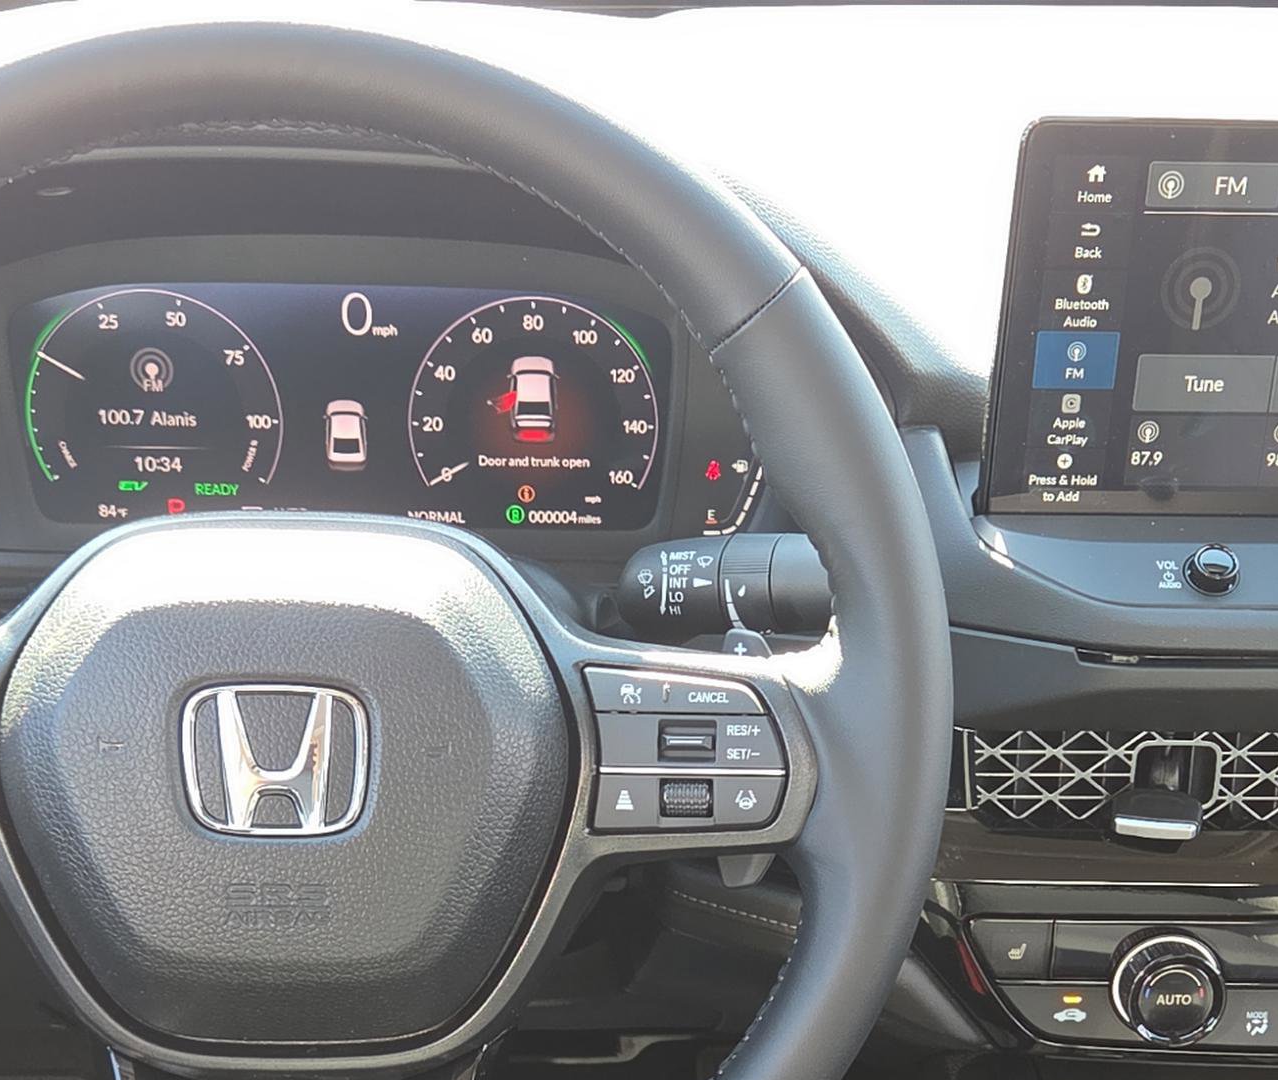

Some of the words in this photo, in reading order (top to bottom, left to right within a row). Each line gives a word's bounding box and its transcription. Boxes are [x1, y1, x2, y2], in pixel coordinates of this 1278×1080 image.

[1215, 177, 1248, 196] FM
[1077, 190, 1112, 203] Home
[1074, 246, 1102, 260] Back
[1054, 298, 1109, 311] Bluetooth
[99, 313, 119, 330] 25
[166, 311, 187, 328] 50
[341, 292, 373, 336] 0
[372, 324, 398, 339] mph
[1063, 315, 1097, 328] Audio
[523, 315, 544, 331] 80
[472, 329, 493, 344] 60
[572, 330, 598, 345] 100
[223, 350, 245, 366] 75
[434, 366, 456, 382] 40
[610, 368, 635, 384] 120
[1065, 368, 1084, 380] FM
[143, 379, 163, 393] FM
[1184, 375, 1224, 393] Tune
[98, 410, 144, 426] 100.7
[150, 411, 197, 427] Alanis
[246, 414, 271, 429] 100
[423, 417, 444, 432] 20
[1053, 417, 1086, 431] Apple
[623, 420, 648, 434] 140
[1047, 433, 1089, 447] CarPlay
[134, 456, 182, 472] 10:34
[478, 455, 506, 468] Door
[508, 455, 528, 468] and
[531, 455, 560, 468] trunk
[562, 458, 590, 470] open
[1130, 451, 1163, 467] 87.9
[608, 470, 633, 485] 160
[1028, 474, 1056, 487] Press
[1059, 474, 1068, 486] &
[1070, 474, 1097, 487] Hold
[194, 482, 239, 495] READY
[1042, 491, 1054, 503] to
[1057, 490, 1080, 503] Add
[528, 510, 577, 525] 000004
[707, 509, 715, 520] E
[669, 550, 697, 561] MIST
[669, 564, 692, 576] OFF
[1156, 560, 1179, 570] VOL
[669, 577, 689, 589] INT
[669, 592, 684, 603] LO
[669, 605, 682, 615] HI
[688, 692, 729, 704] CANCEL
[726, 724, 761, 737] RES/+
[1156, 992, 1192, 1006] AUTO
[1246, 1011, 1268, 1019] MODE
